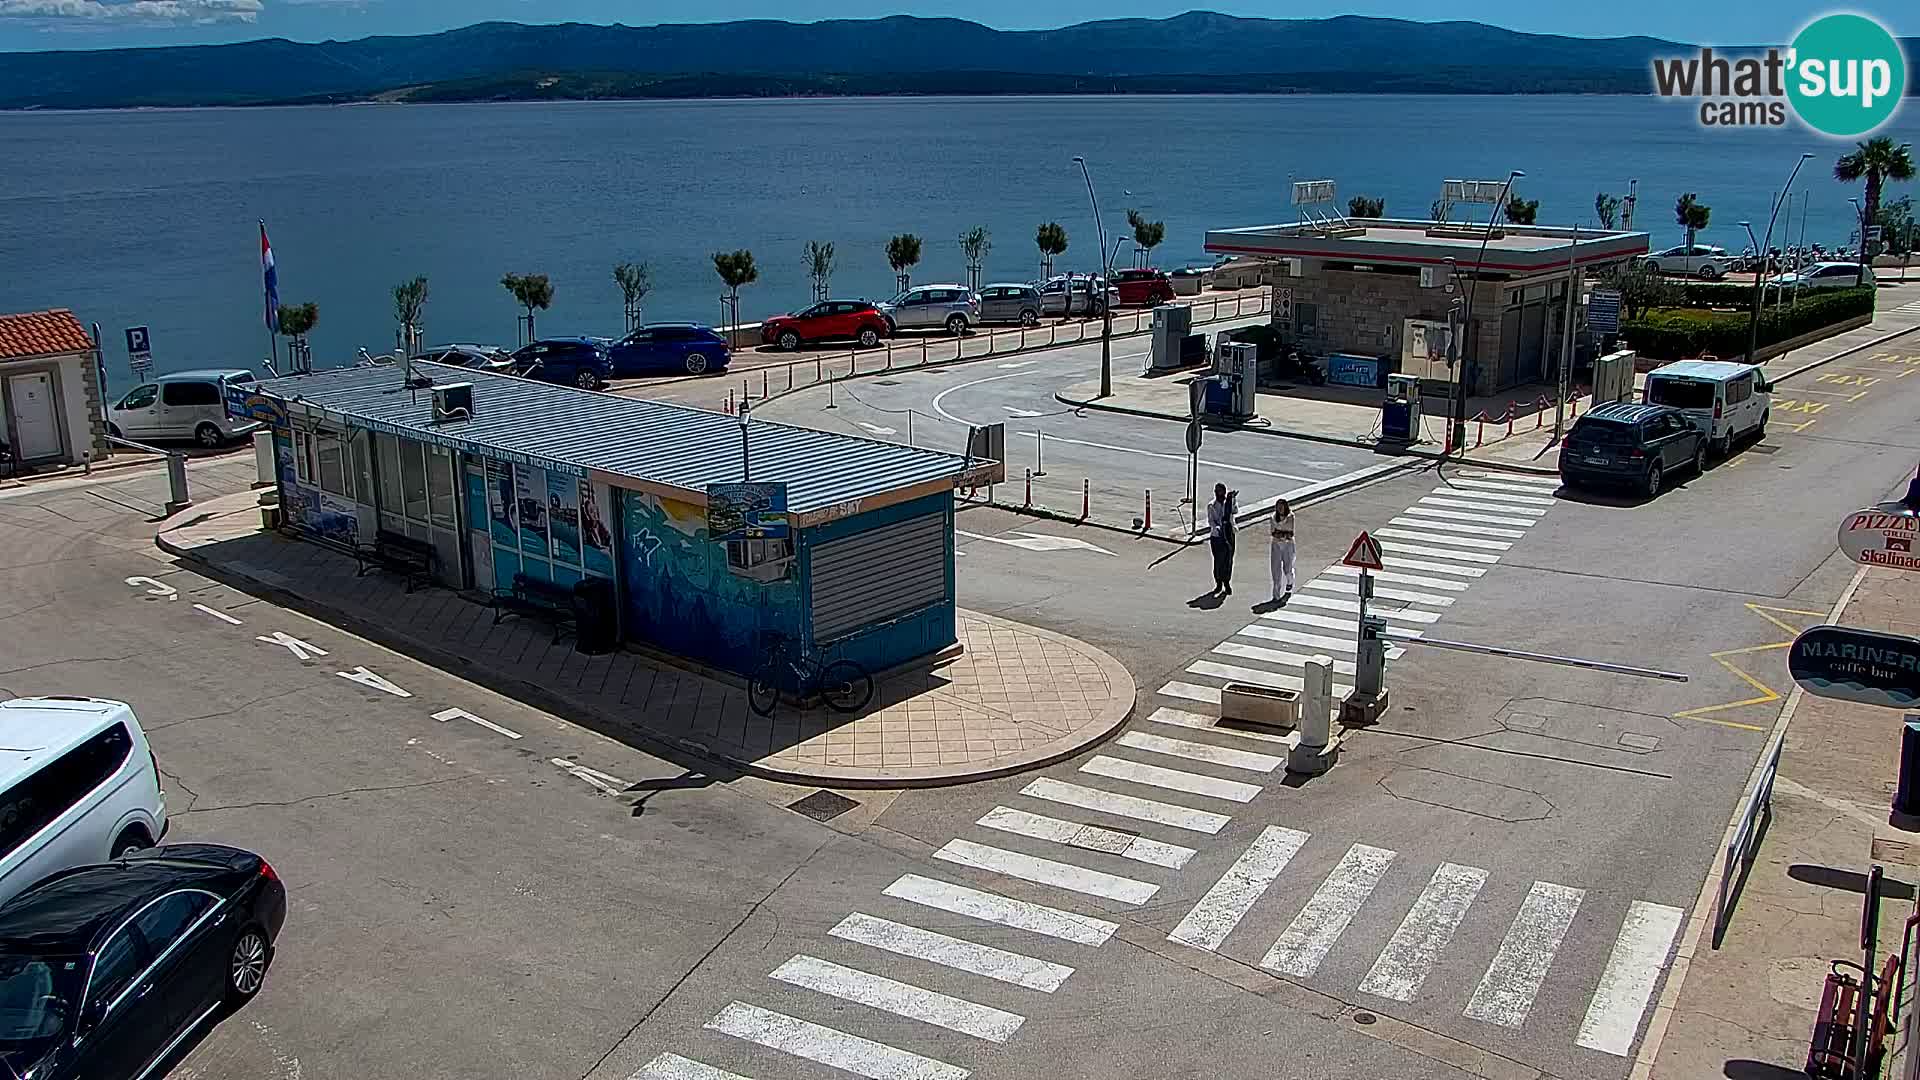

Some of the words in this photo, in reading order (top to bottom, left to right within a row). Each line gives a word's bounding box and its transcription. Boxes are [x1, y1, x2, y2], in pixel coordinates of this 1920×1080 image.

[131, 331, 143, 349] P
[1816, 373, 1880, 387] TAXI
[437, 436, 469, 452] POSTAJA
[479, 445, 495, 457] BUS
[494, 449, 527, 464] STATION
[528, 456, 556, 471] TICKET
[555, 462, 583, 477] OFFICE
[1882, 530, 1917, 541] GRILL
[1829, 662, 1867, 673] caffe
[1871, 665, 1897, 680] bar
